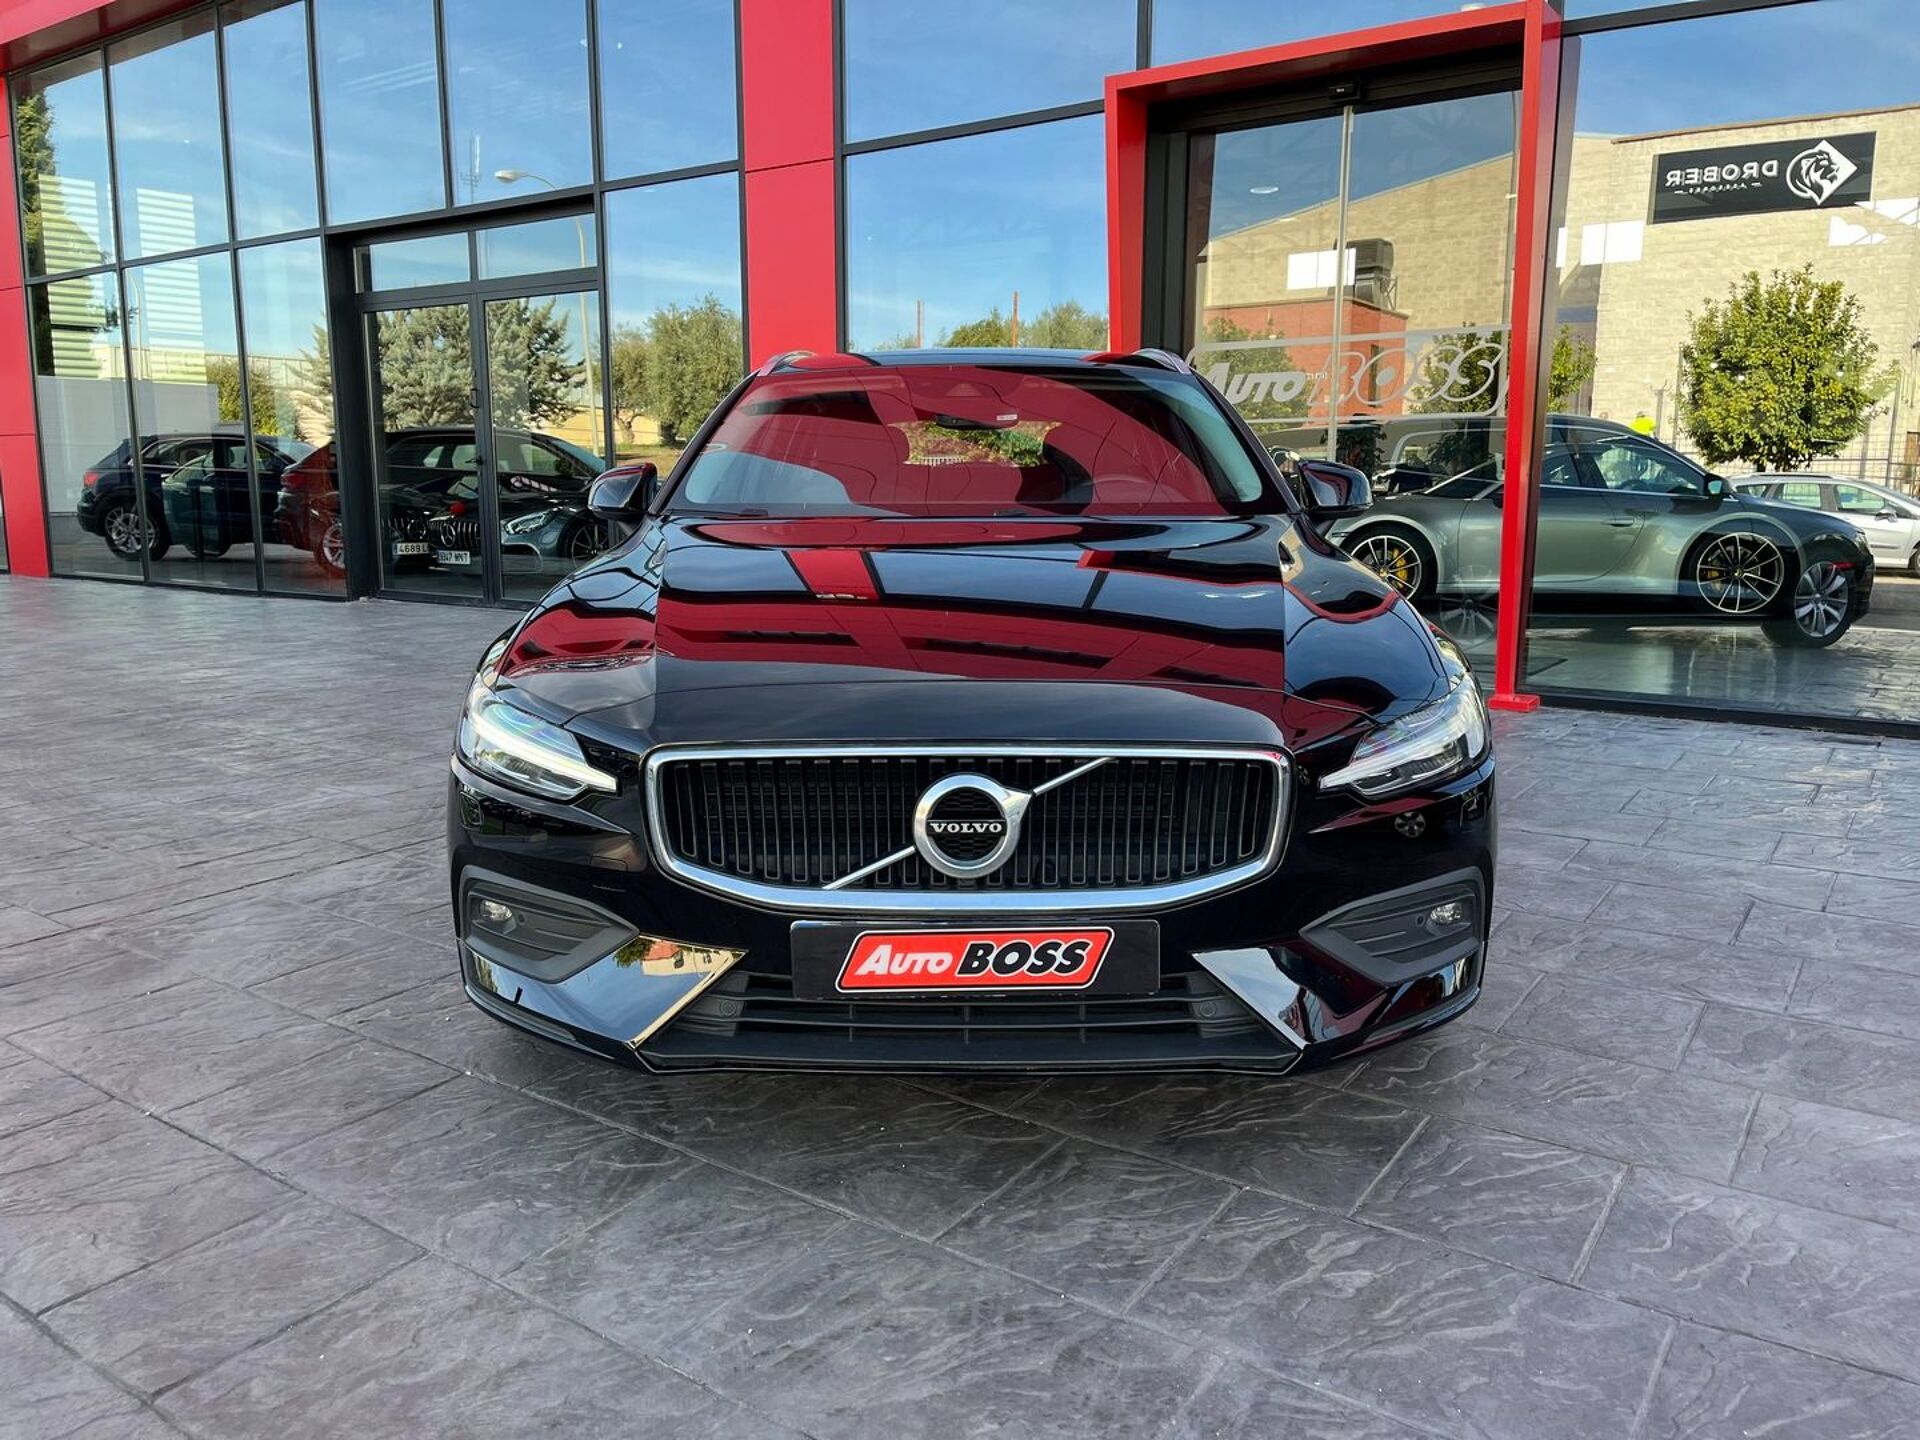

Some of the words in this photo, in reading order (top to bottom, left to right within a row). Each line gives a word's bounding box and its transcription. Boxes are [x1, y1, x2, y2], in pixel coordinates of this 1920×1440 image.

[1307, 343, 1505, 406] BOSS
[930, 823, 1003, 833] VOLVO
[955, 939, 1093, 977] BOSS
